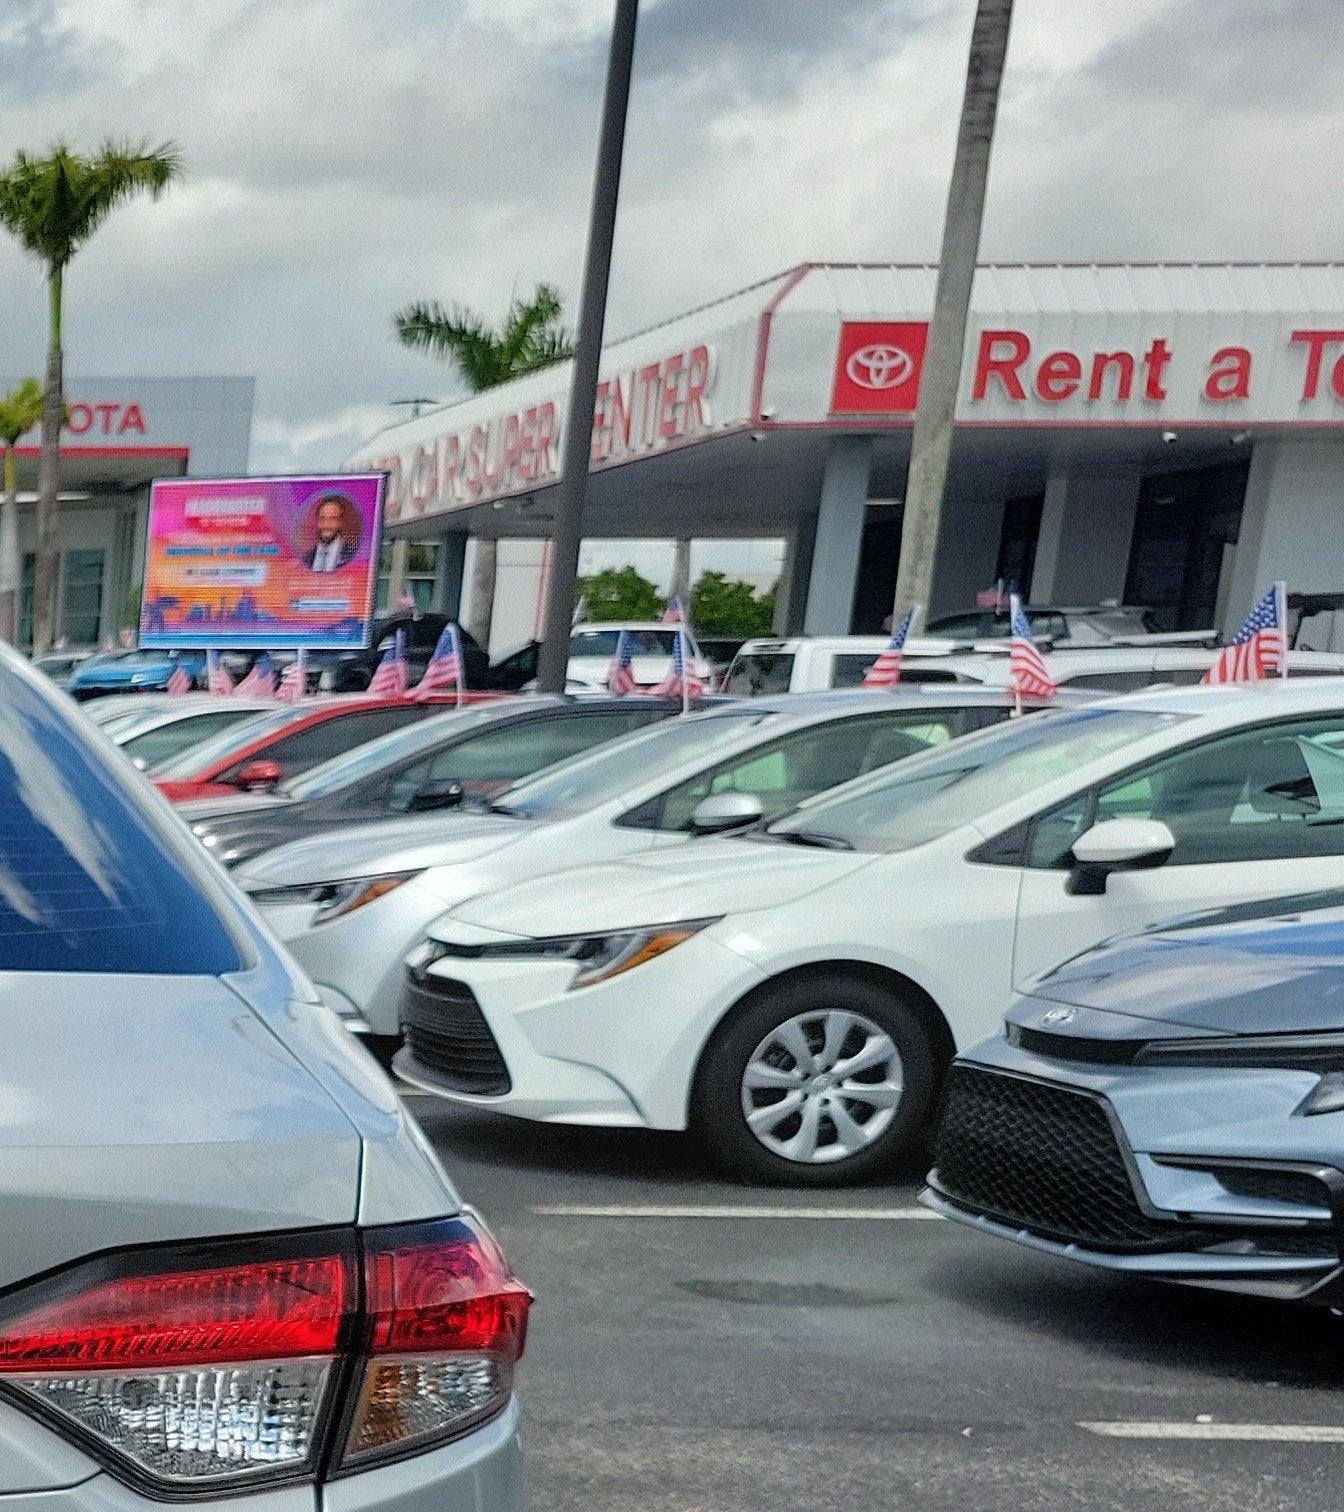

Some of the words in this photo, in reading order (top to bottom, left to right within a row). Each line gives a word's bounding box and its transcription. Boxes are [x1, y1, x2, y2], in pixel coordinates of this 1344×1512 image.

[591, 345, 714, 466] ENTER
[971, 329, 1172, 402] Rent
[1206, 345, 1252, 400] a
